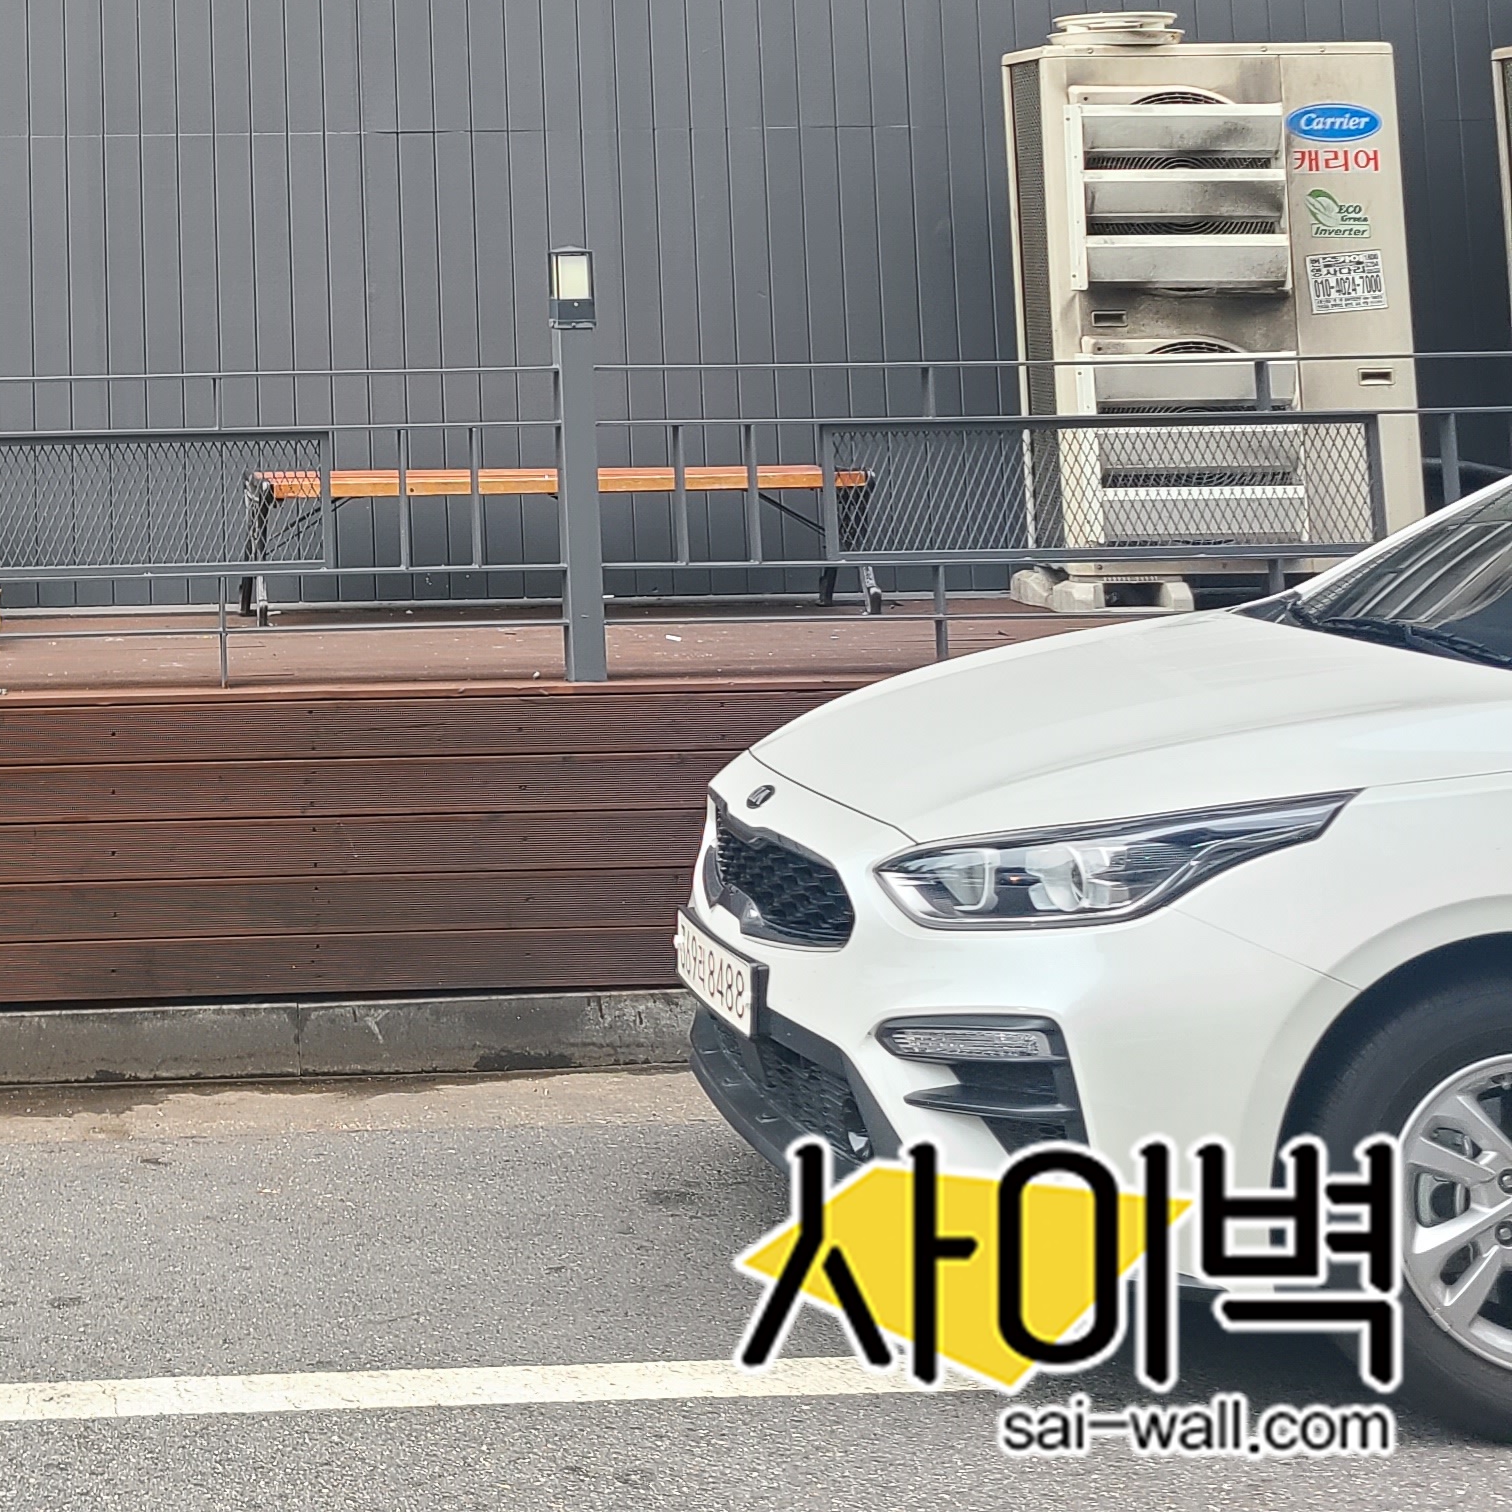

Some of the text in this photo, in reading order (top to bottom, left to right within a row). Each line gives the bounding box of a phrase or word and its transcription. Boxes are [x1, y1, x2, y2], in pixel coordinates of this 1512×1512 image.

[1300, 112, 1370, 130] Carrier
[1292, 149, 1380, 172] 캐리어
[1337, 204, 1363, 215] ECO
[1314, 226, 1368, 237] Inverter
[1313, 274, 1383, 298] 010-4024-7000
